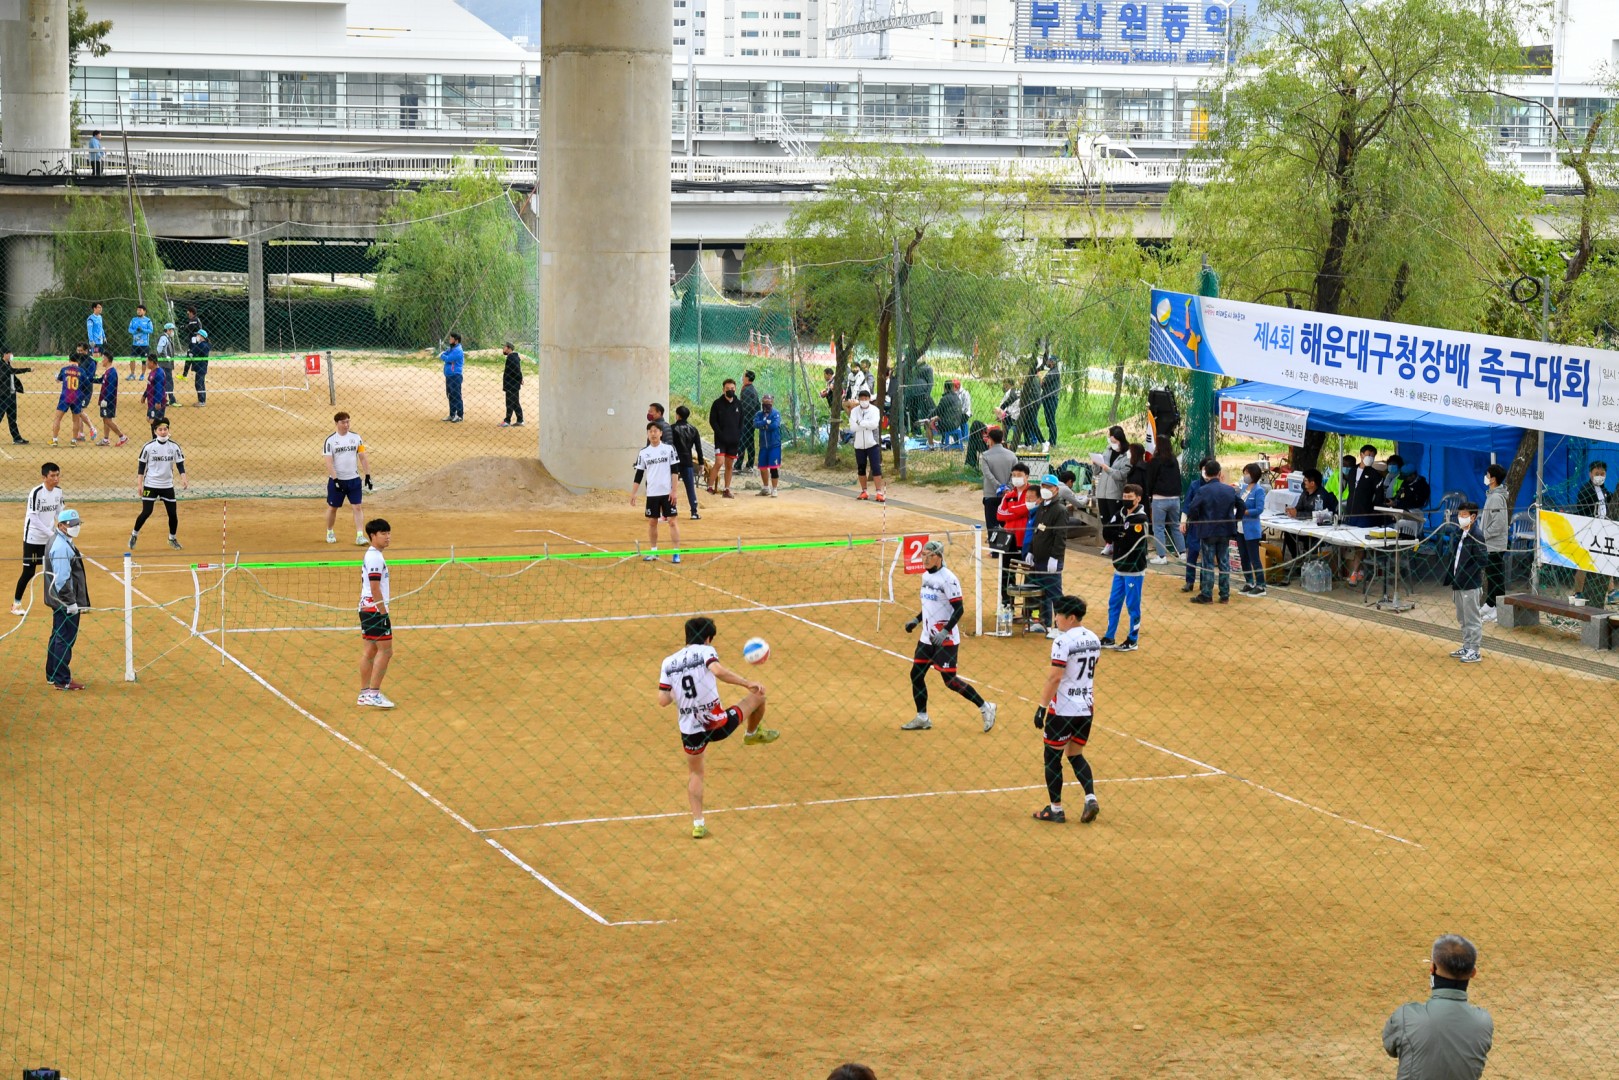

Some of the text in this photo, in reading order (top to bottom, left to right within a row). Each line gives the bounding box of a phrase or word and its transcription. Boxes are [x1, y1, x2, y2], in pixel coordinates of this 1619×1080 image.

[1024, 45, 1130, 65] Busanwondong
[1132, 47, 1178, 63] Station
[310, 357, 315, 369] 1
[1254, 322, 1591, 407] 제4회 해운대구청장배 족구대회
[66, 375, 79, 391] 10
[1284, 369, 1359, 390] 주최 주관 해운대구족구협회
[1393, 387, 1405, 398] 후원
[1416, 391, 1438, 403] 해운대구
[1504, 405, 1545, 421] 부산시족구협회
[1601, 395, 1615, 406] 장소
[1238, 413, 1304, 439] 효성시티병원 의료지원팀
[1588, 418, 1602, 430] 협찬
[910, 540, 923, 563] 2
[1589, 535, 1619, 557] 스포
[1076, 656, 1096, 681] 79
[682, 674, 698, 699] 9
